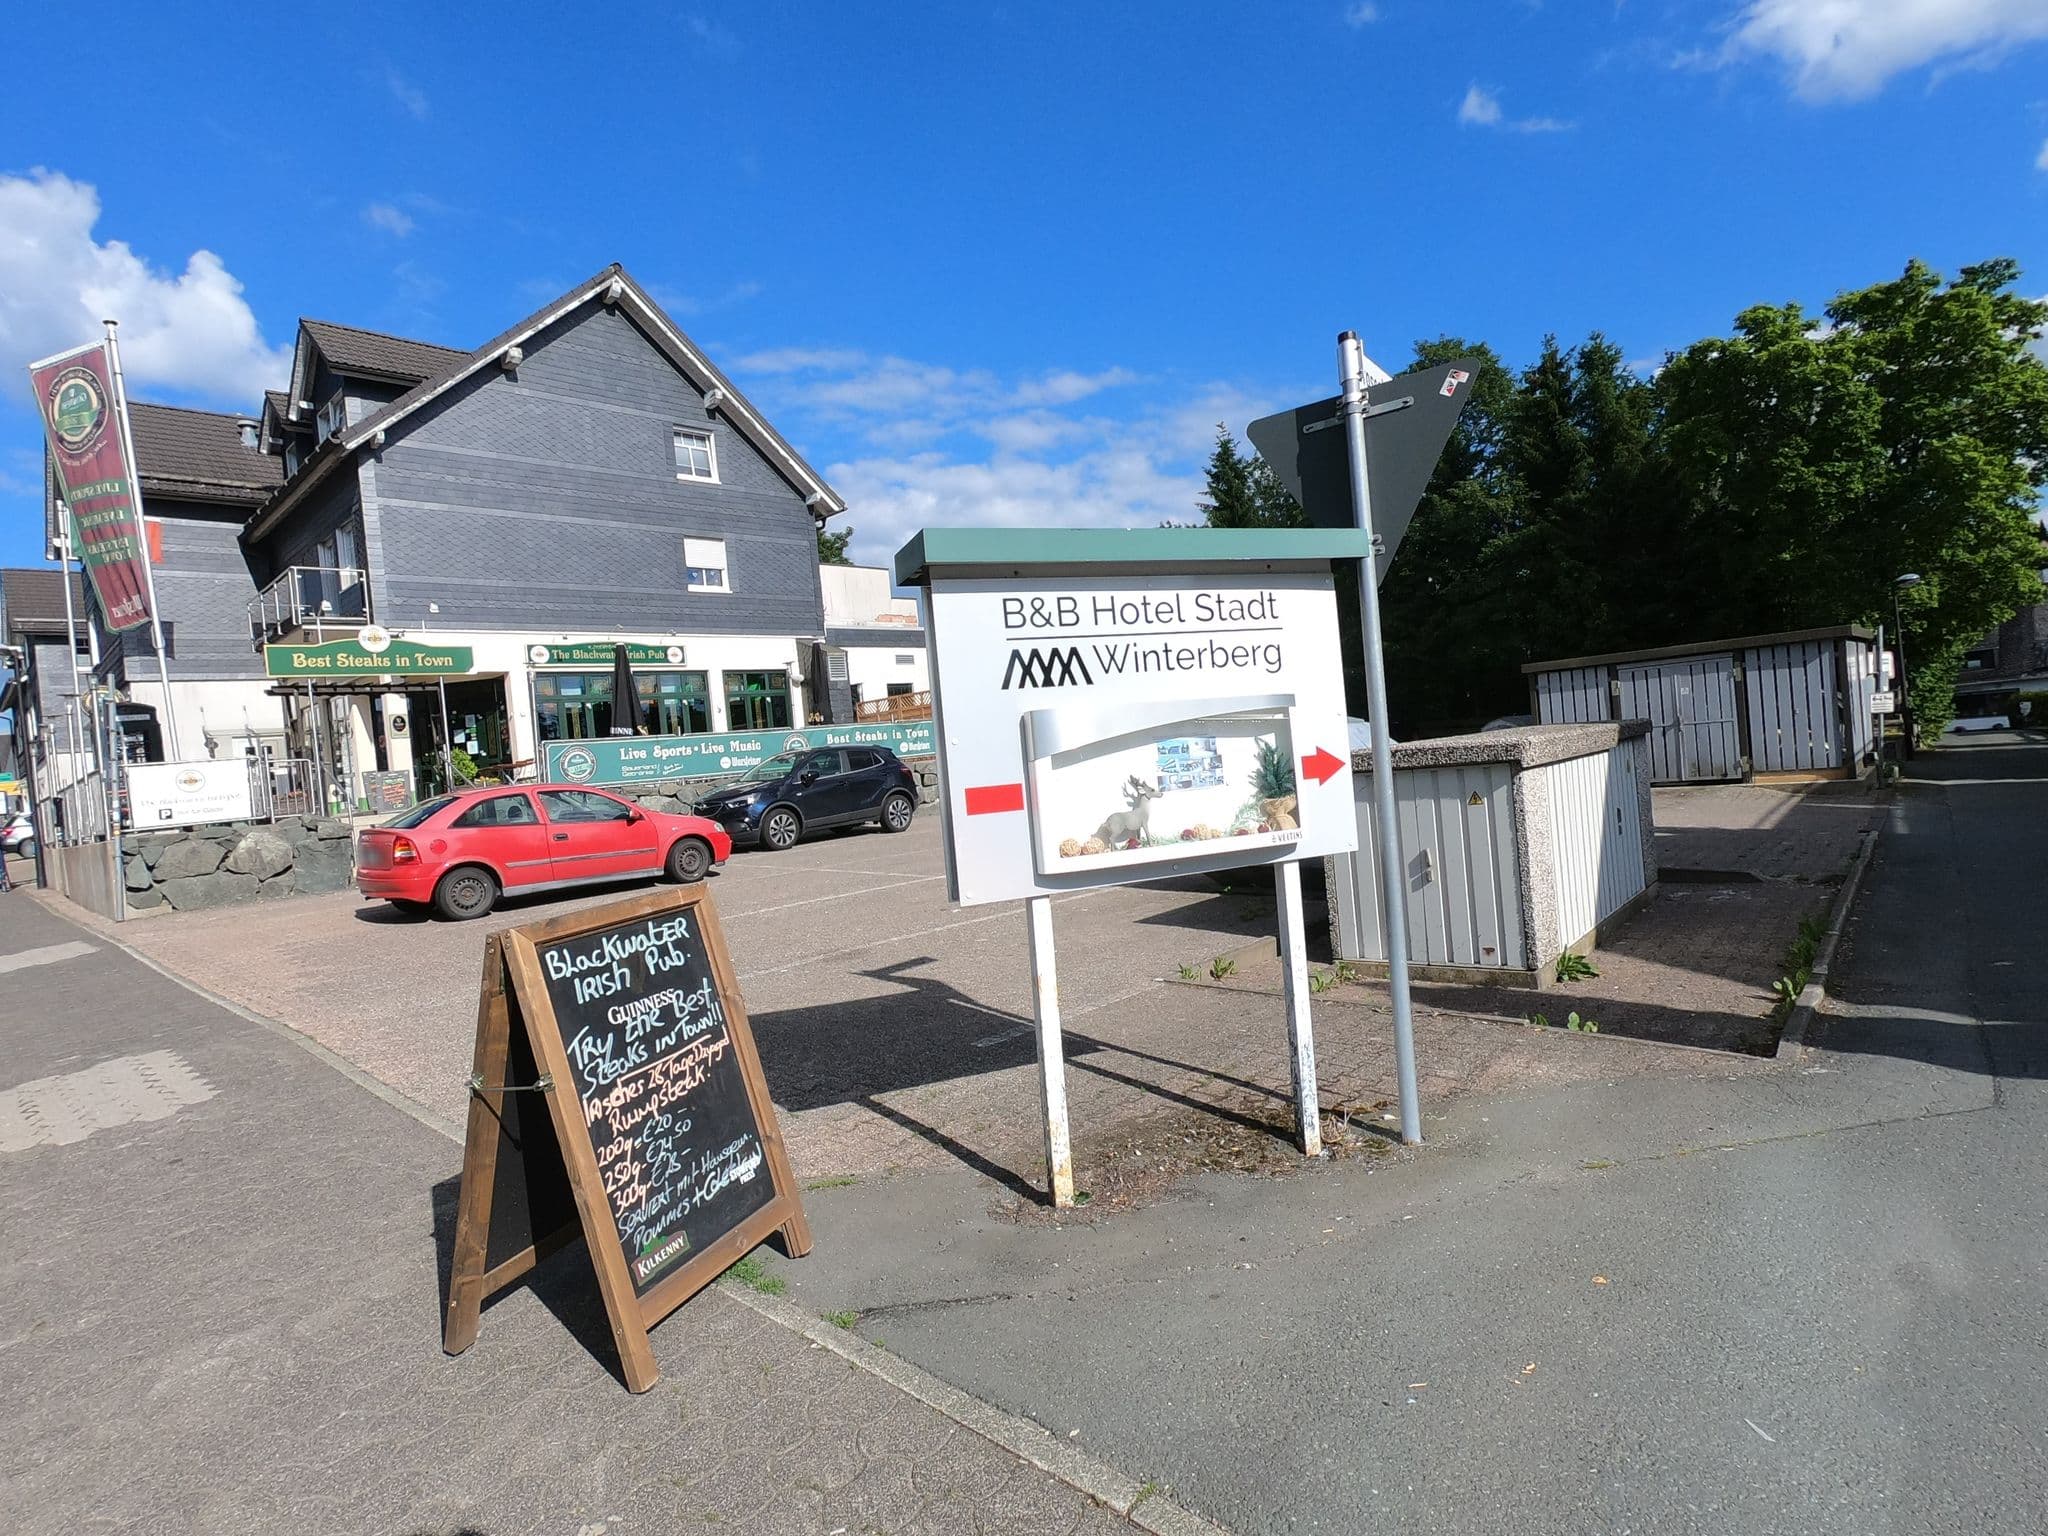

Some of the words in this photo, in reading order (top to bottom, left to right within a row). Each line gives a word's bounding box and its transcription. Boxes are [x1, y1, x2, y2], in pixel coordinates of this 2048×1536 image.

[1002, 596, 1080, 629] B&B
[1092, 592, 1186, 626] Hotel
[1195, 591, 1279, 622] Stadt
[292, 652, 331, 668] Best
[336, 652, 391, 668] Steaks
[396, 653, 411, 667] in
[414, 652, 454, 667] Town
[552, 649, 570, 660] The
[648, 649, 665, 660] Pub
[1092, 639, 1282, 675] Winterberg
[620, 746, 647, 760] Live
[653, 744, 692, 761] Sports
[701, 742, 724, 755] Live
[730, 739, 761, 752] Music
[827, 733, 850, 745] Best
[855, 731, 887, 742] Steaks
[893, 729, 901, 740] in
[906, 728, 930, 739] Town
[607, 988, 677, 1026] GUINNESS
[673, 977, 712, 1018] Best
[648, 1063, 665, 1089] 28
[637, 1235, 685, 1278] KILKENNY
